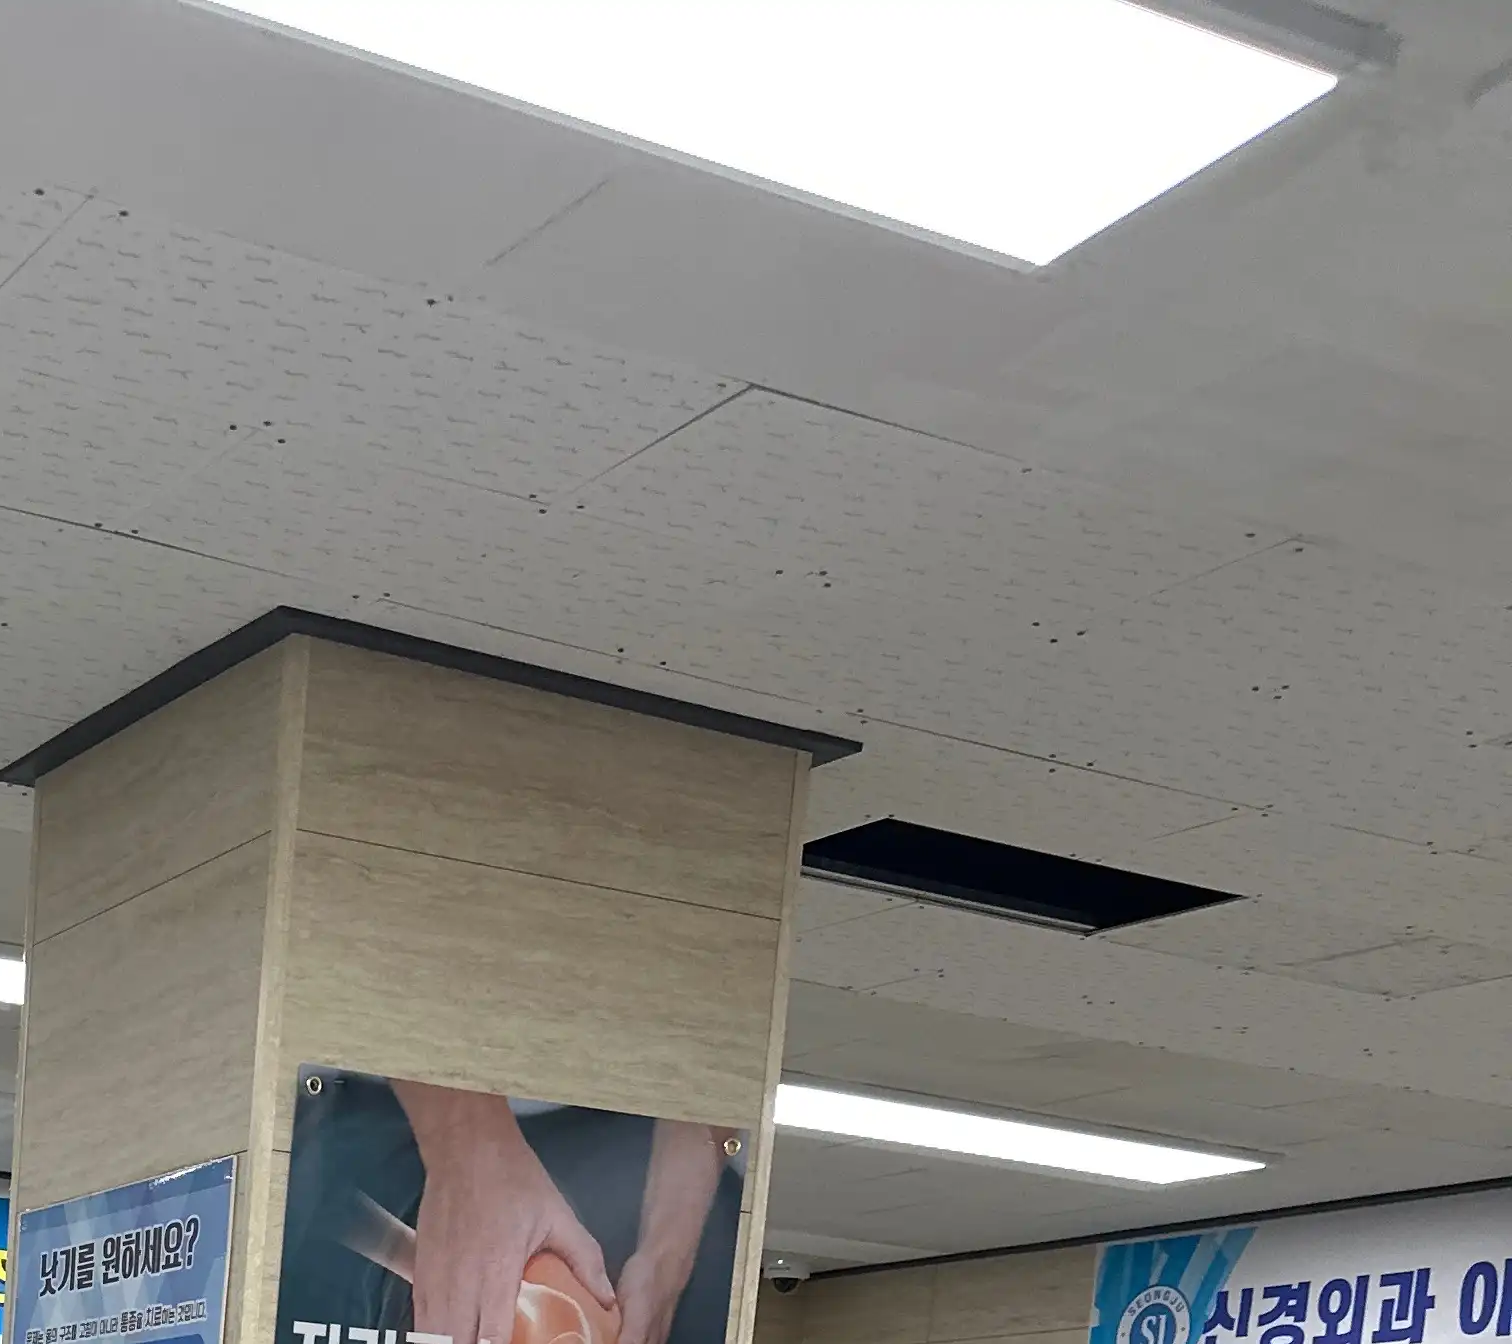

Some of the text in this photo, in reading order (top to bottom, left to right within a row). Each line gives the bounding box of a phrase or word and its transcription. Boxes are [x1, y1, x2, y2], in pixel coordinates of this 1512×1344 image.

[39, 1242, 95, 1297] 낫기를
[101, 1217, 200, 1285] 원하세요?
[1127, 1288, 1186, 1317] SEONGJU
[120, 1310, 143, 1333] 통증을
